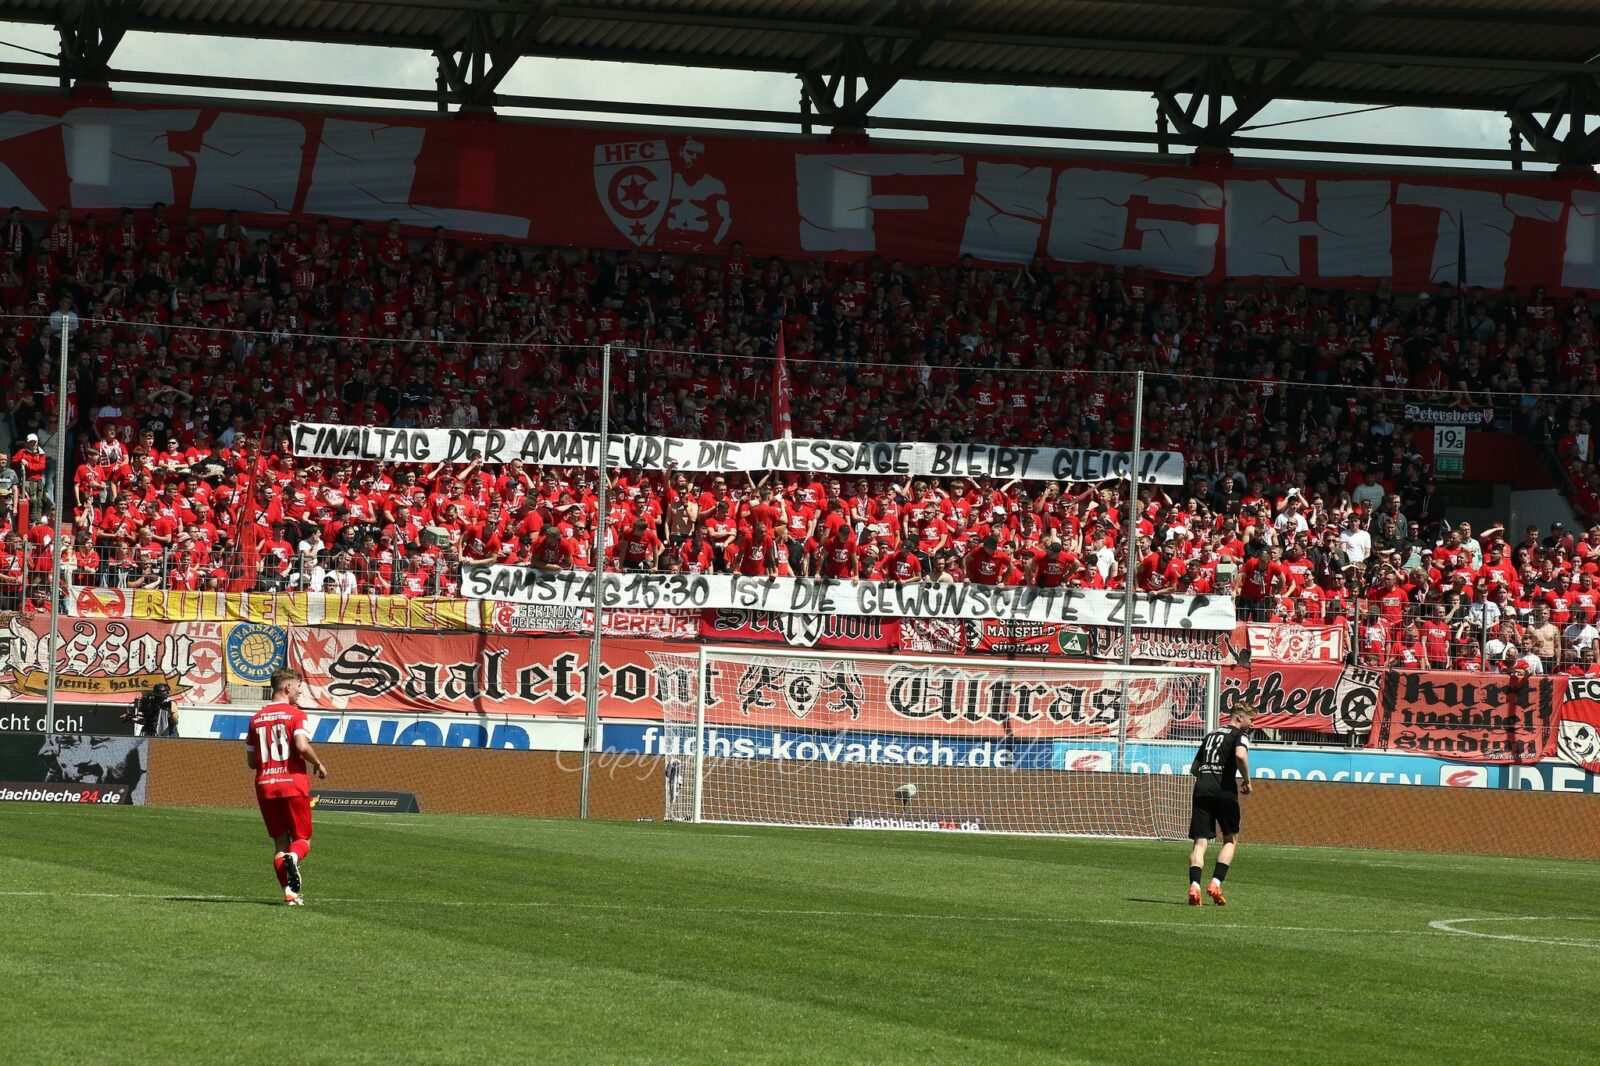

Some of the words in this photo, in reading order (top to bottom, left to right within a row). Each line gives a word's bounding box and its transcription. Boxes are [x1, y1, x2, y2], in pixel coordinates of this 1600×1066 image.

[604, 142, 656, 162] HFC
[294, 426, 431, 460] FINALTAG
[447, 429, 507, 463] DER
[699, 441, 743, 471] DIE
[761, 440, 914, 474] MESSAGE
[930, 443, 1040, 477] BLEIBT
[1437, 430, 1463, 449] 19a
[132, 588, 309, 626] BULLEN
[468, 567, 622, 605] SAMSTAG
[624, 574, 709, 608] 15:30
[731, 576, 780, 605] IST
[789, 578, 839, 612] DIE
[856, 580, 1085, 622] GEWÜNSCHTE
[1105, 591, 1209, 628] ZEIT!
[987, 625, 1057, 638] MANSFELD
[990, 642, 1049, 654] SÜDHARZ
[36, 714, 83, 732] dch!
[256, 723, 290, 764] 18
[642, 727, 1014, 768] fuchs-kovatsch.de
[1205, 734, 1225, 763] 42
